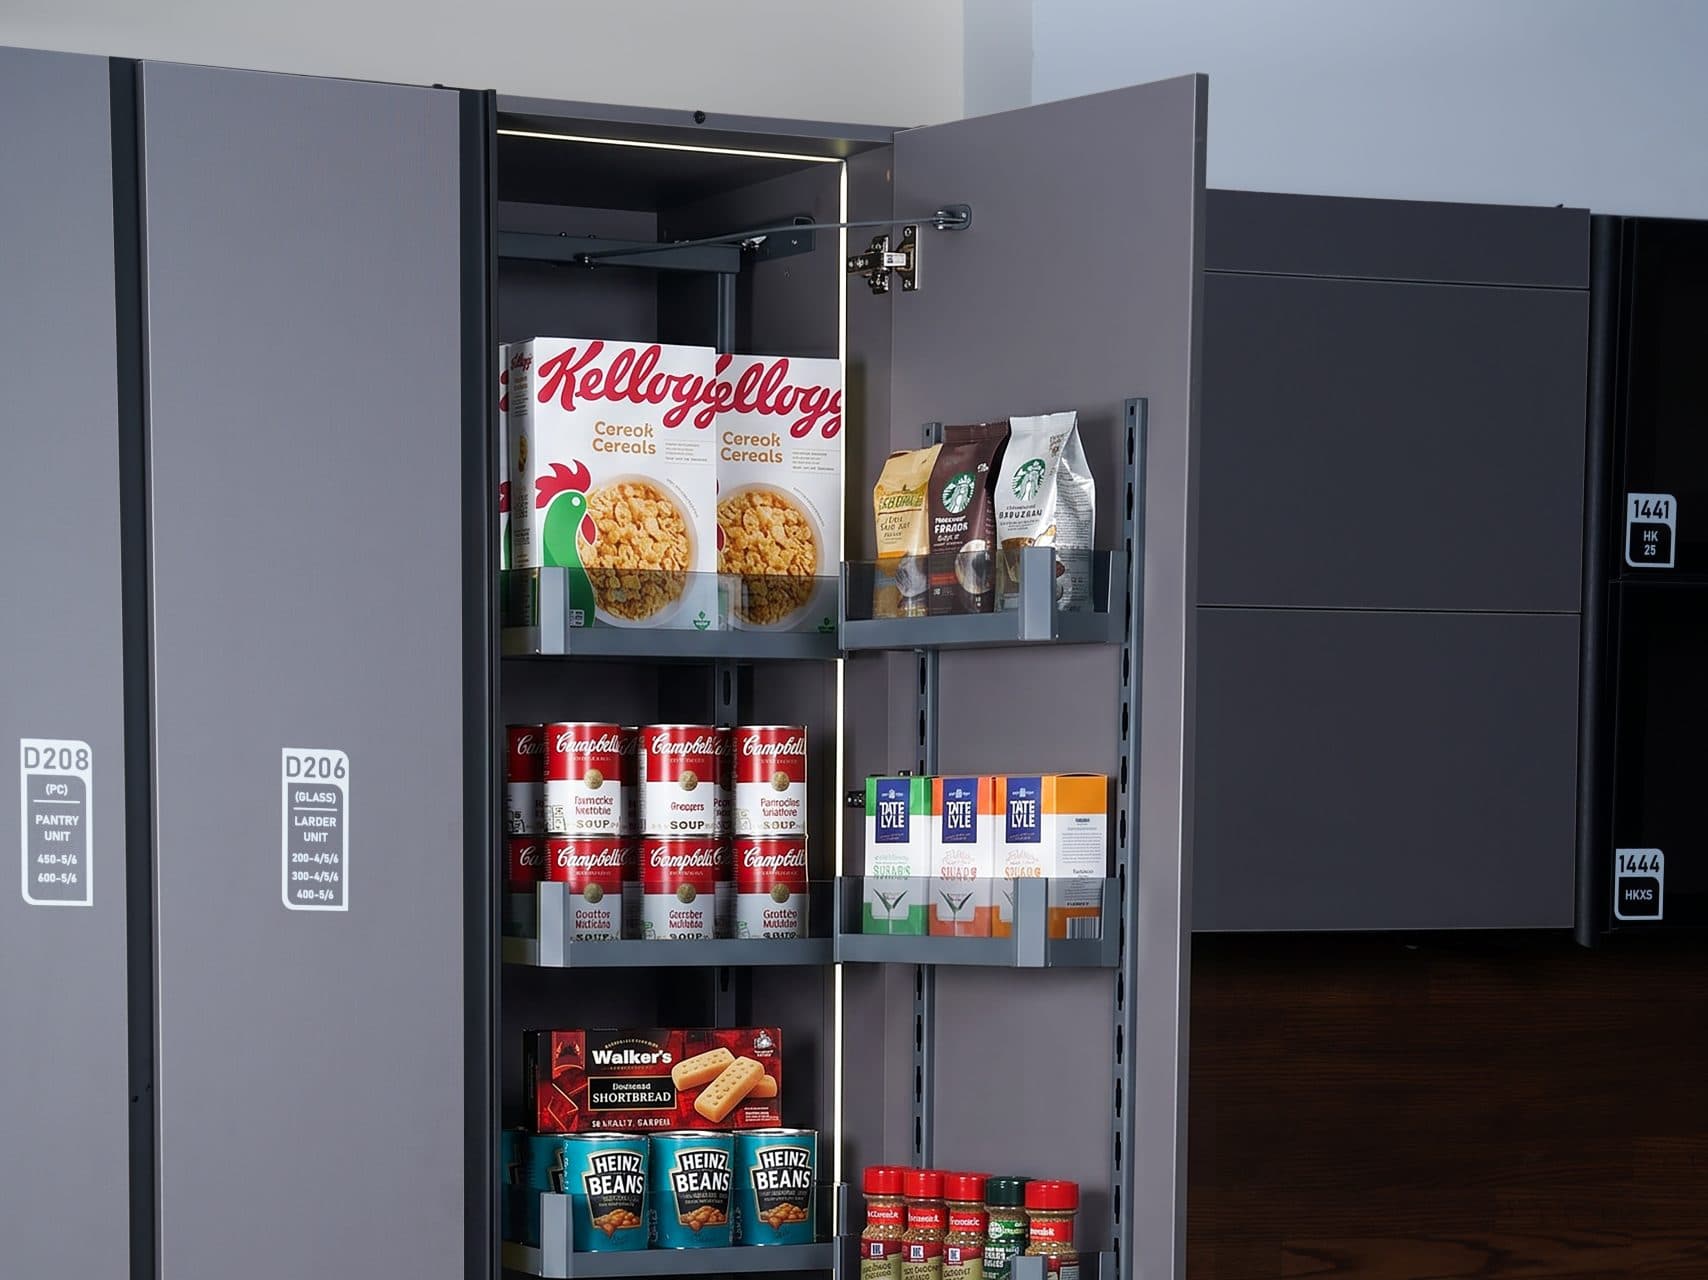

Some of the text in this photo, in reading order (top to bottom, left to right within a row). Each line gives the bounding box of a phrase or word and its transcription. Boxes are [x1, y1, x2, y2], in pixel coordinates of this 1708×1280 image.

[592, 438, 656, 455] Cereals
[720, 447, 783, 463] Cereals
[1634, 499, 1669, 519] 1441
[1643, 530, 1659, 542] HK
[1644, 544, 1656, 555] 25
[24, 747, 89, 770] D208
[286, 756, 346, 779] D206
[45, 784, 68, 796] (PC)
[295, 791, 336, 804] (GLASS)
[1009, 800, 1035, 814] TATE
[35, 815, 79, 826] PANTRY
[295, 816, 336, 827] LARDER
[576, 820, 610, 829] SOUP
[670, 820, 705, 830] SOUP
[763, 820, 796, 830] SOUP
[881, 815, 904, 828] LYLE
[948, 815, 971, 828] LYLE
[1012, 814, 1035, 828] LYLE
[44, 831, 71, 841] UNIT
[303, 832, 328, 842] UNIT
[37, 854, 77, 866] 450-5/6
[292, 853, 339, 864] 200-4/5/6
[1619, 854, 1660, 873] 1444
[37, 873, 77, 884] 600-5/6
[292, 871, 339, 883] 300-4/5/6
[296, 889, 334, 901] 400-5/6
[1625, 889, 1653, 901] HKXS
[592, 1049, 672, 1065] Walker's
[592, 1092, 671, 1104] SHORTBREAD
[595, 1155, 640, 1173] HEINZ
[683, 1152, 725, 1171] HEINZ
[761, 1150, 806, 1168] HEINZ
[589, 1173, 644, 1196] BEANS
[677, 1171, 729, 1193] BEANS
[756, 1168, 811, 1190] BEANS
